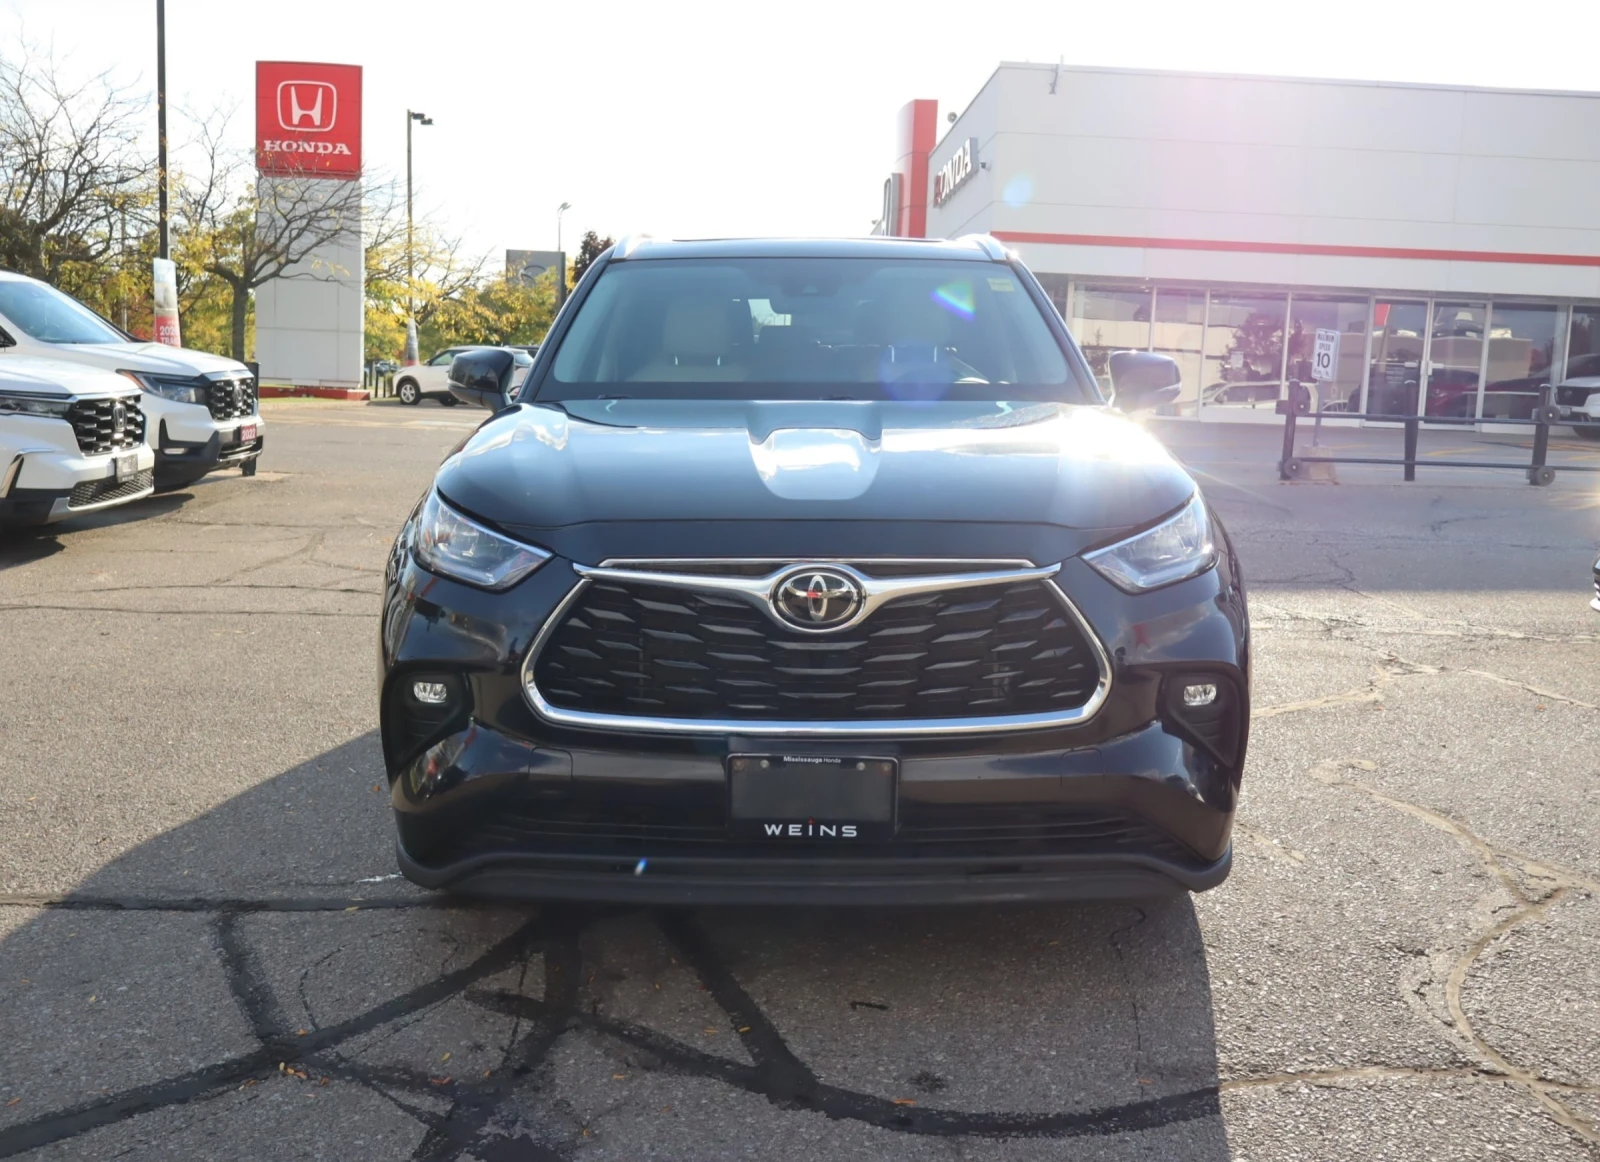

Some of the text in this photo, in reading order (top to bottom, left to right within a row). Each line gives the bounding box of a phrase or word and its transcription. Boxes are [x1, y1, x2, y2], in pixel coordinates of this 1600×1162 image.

[263, 140, 352, 155] HONDA
[934, 137, 972, 203] ONDA
[1316, 351, 1331, 369] 10
[783, 755, 842, 764] Mississauga Honda
